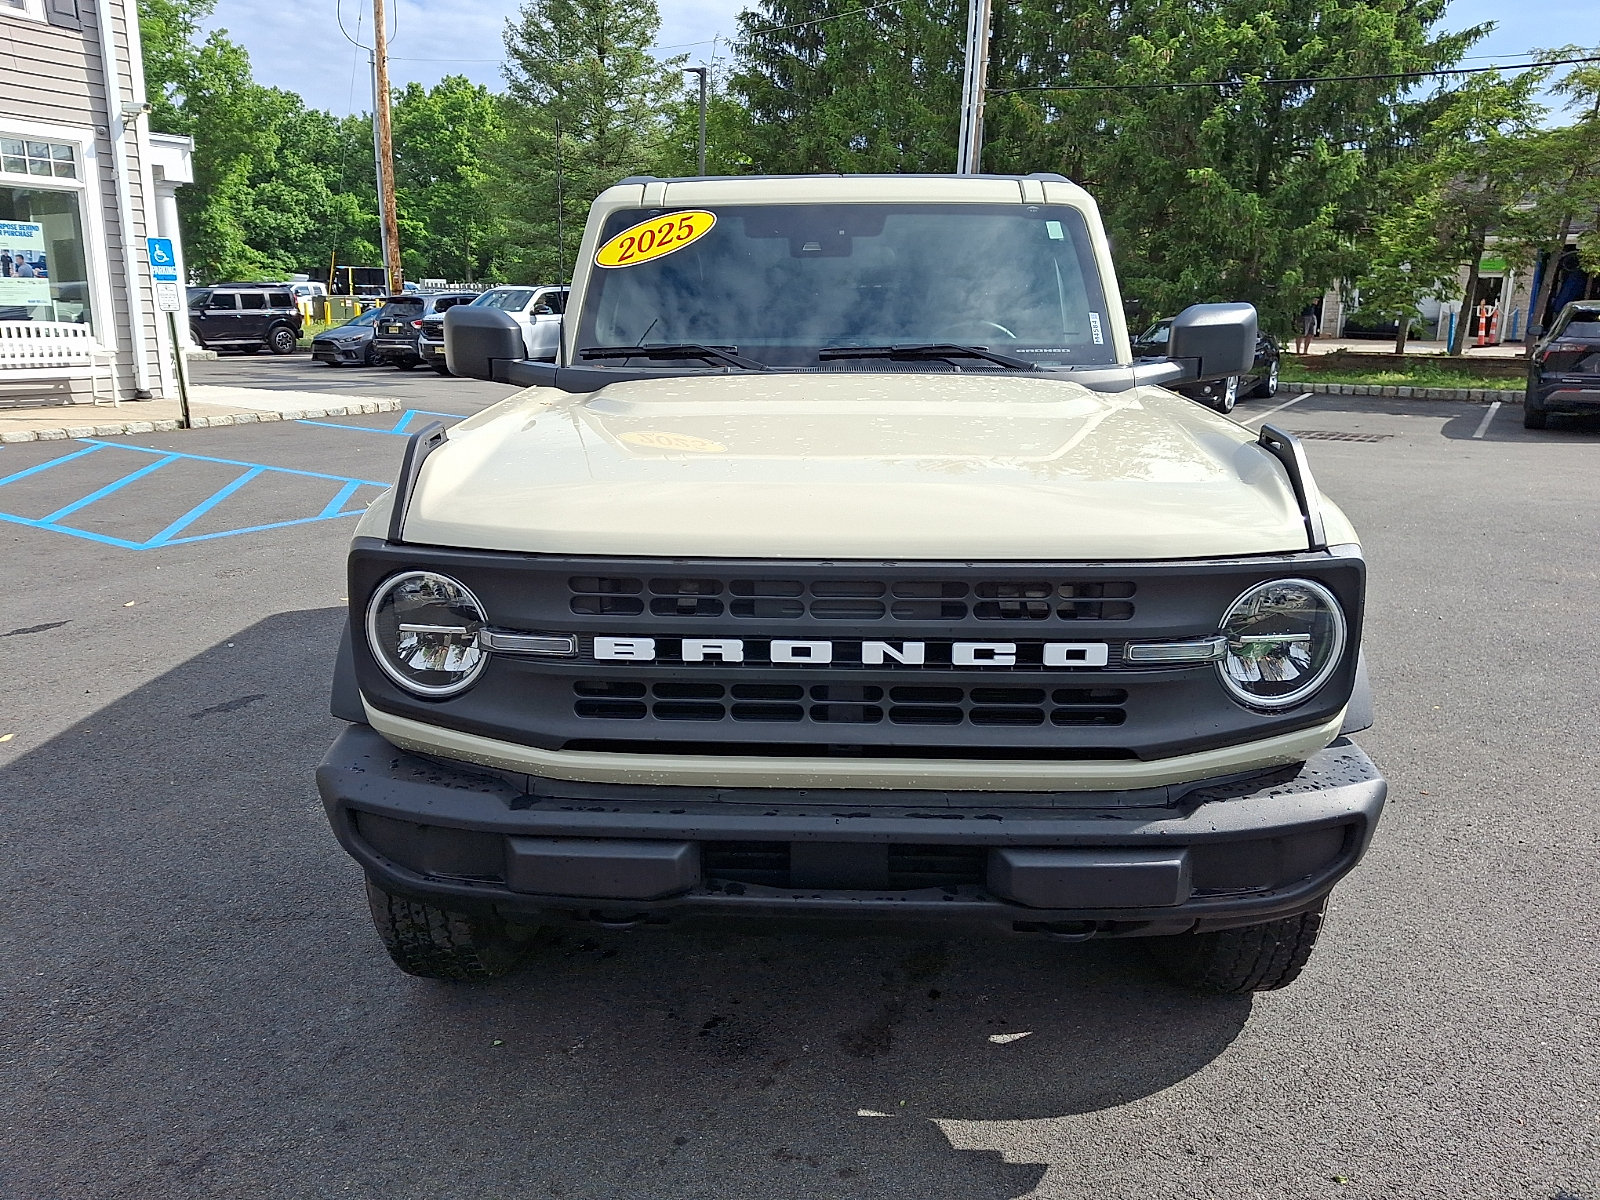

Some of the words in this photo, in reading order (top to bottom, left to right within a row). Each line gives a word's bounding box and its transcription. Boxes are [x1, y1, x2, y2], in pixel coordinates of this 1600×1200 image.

[4, 230, 33, 238] PURCHASE
[18, 224, 40, 232] BEHIND
[617, 215, 694, 263] 2025
[593, 636, 1109, 667] BRONCO
